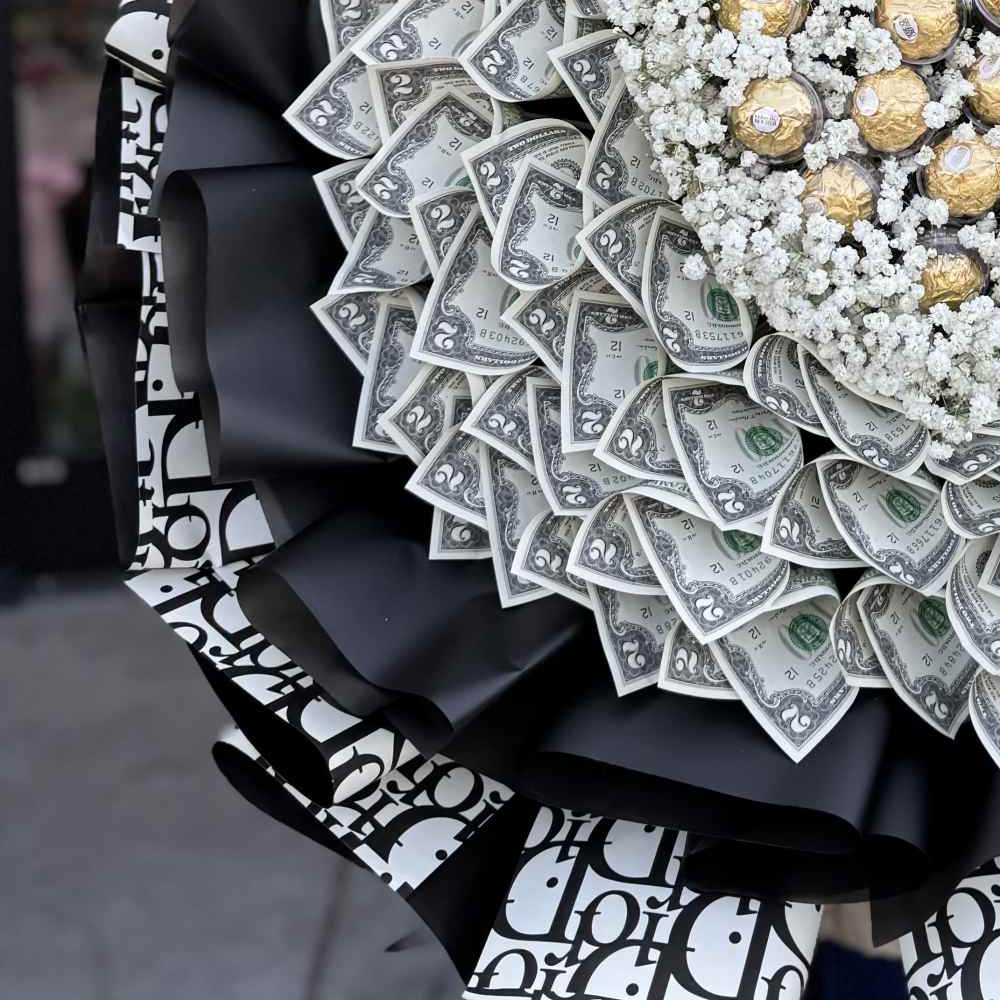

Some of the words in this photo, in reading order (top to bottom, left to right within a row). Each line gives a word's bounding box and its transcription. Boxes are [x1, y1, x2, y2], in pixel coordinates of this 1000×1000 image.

[380, 36, 408, 59] 2
[481, 50, 505, 74] 2
[574, 60, 596, 82] 2
[391, 74, 412, 94] 2
[311, 100, 337, 125] 2
[479, 161, 501, 186] 2
[373, 177, 398, 199] 2
[431, 205, 453, 230] 2
[600, 231, 622, 255] 2
[340, 304, 365, 327] 2
[529, 309, 555, 333] 2
[434, 322, 458, 349] 2
[661, 327, 680, 353] 2
[407, 406, 431, 431] 2
[489, 414, 515, 434] 2
[582, 411, 604, 433] 2
[619, 430, 642, 456] 2
[436, 464, 464, 488] 2
[718, 493, 744, 513] 2
[779, 518, 799, 539] 2
[590, 539, 617, 562] 2
[696, 595, 724, 620] 2
[623, 641, 644, 668] 2
[676, 647, 698, 672] 2
[925, 694, 949, 717] 2
[781, 707, 810, 733] 2
